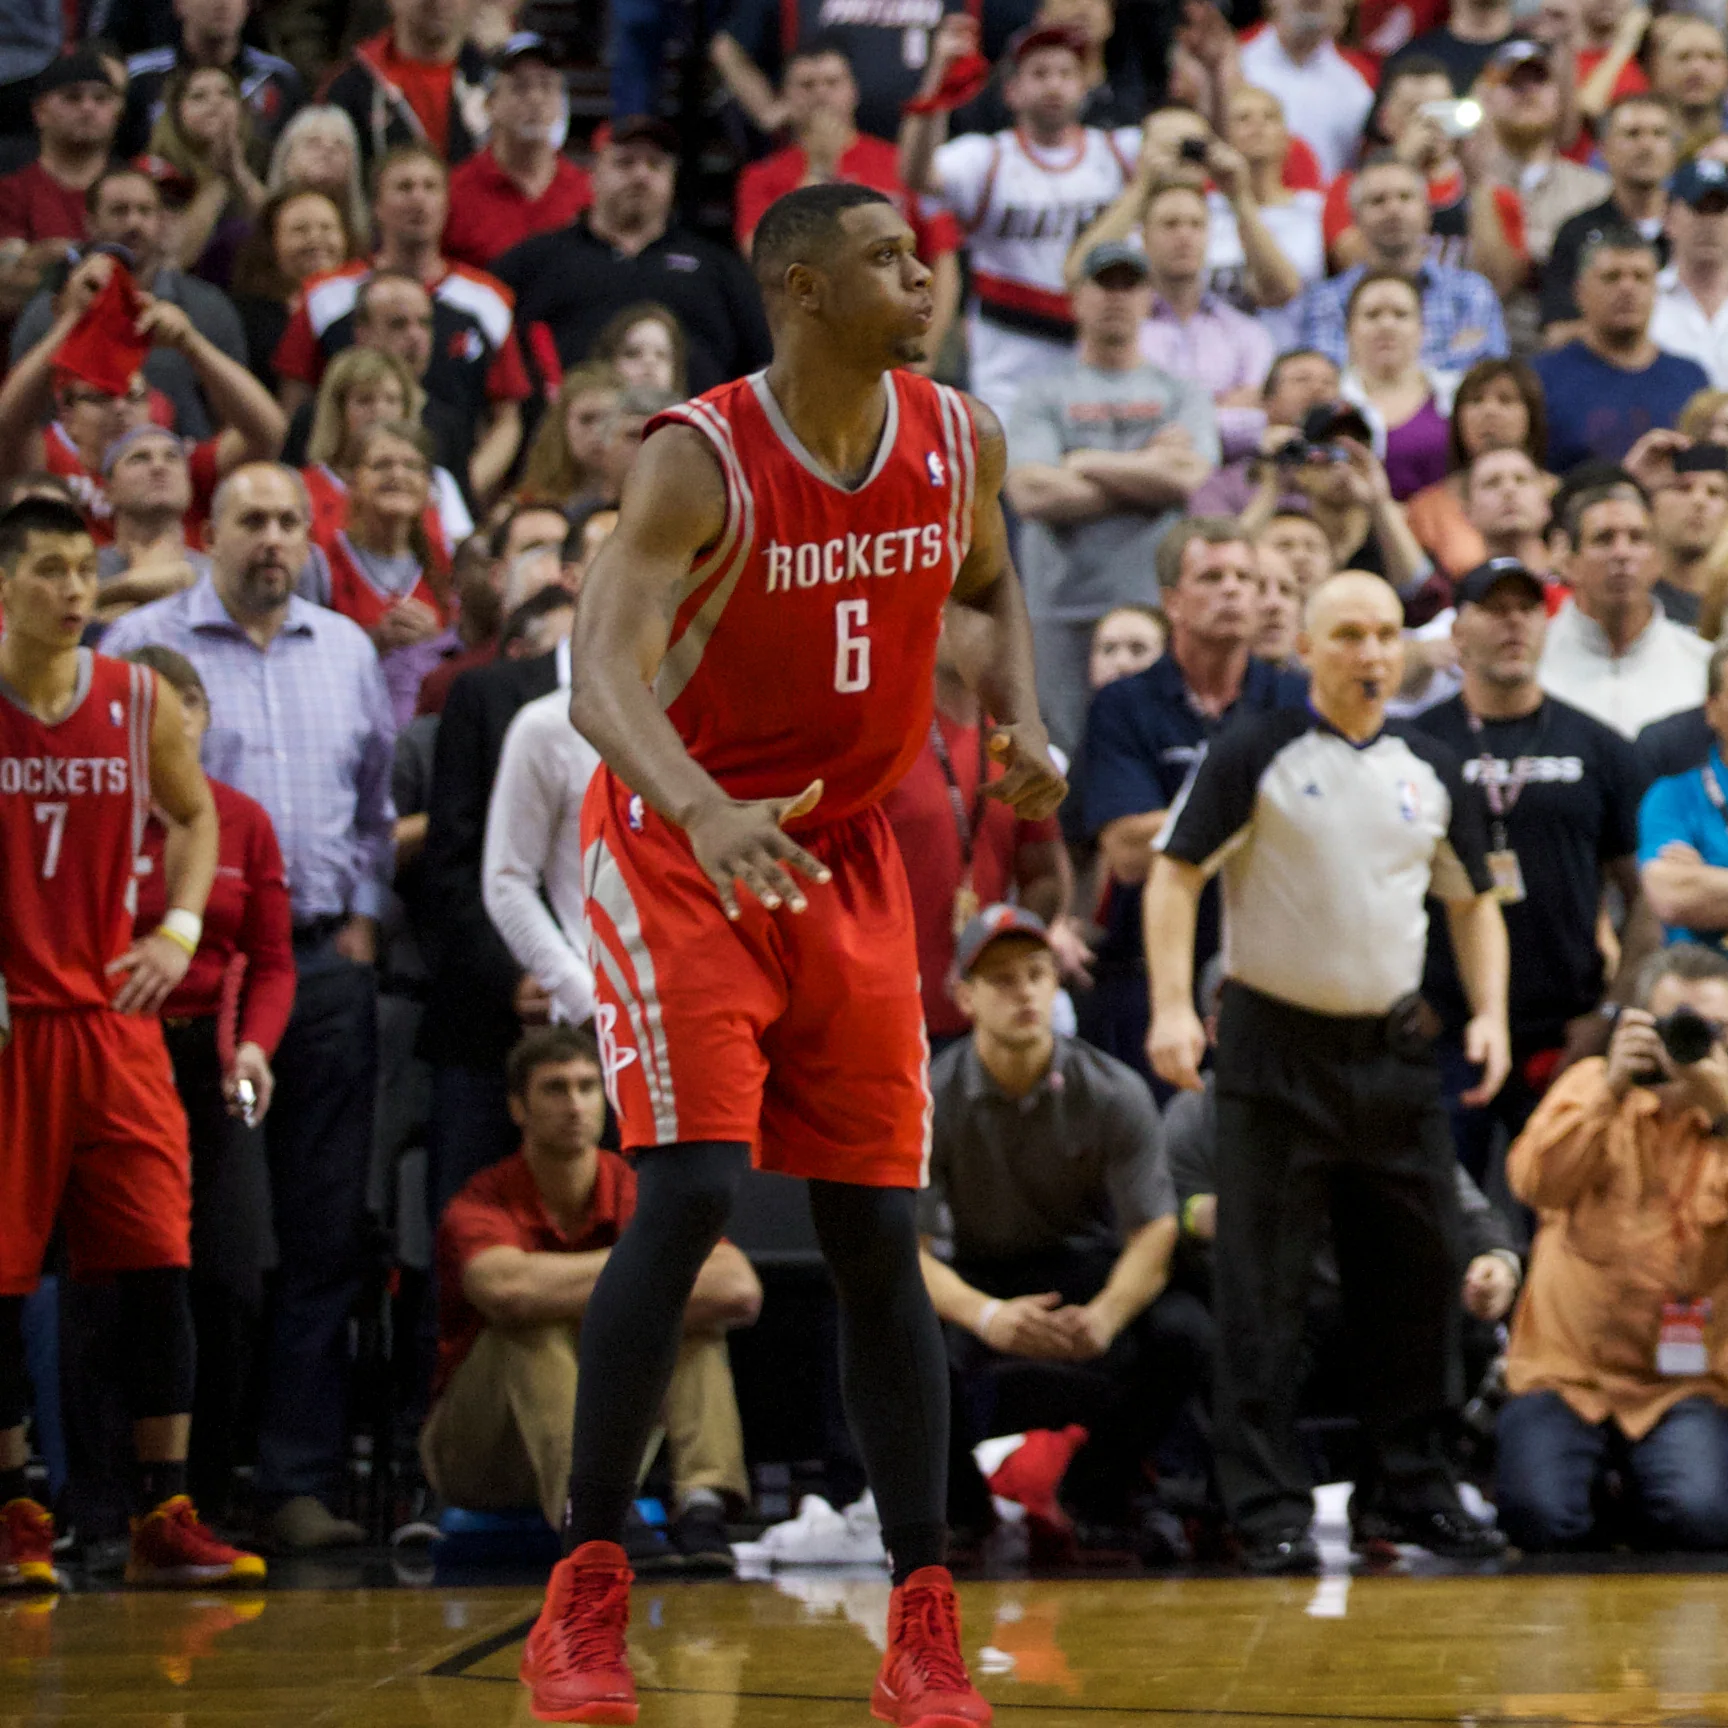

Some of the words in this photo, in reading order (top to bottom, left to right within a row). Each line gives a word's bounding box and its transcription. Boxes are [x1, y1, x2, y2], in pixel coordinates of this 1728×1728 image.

[760, 522, 943, 595] ROCKETS
[832, 597, 872, 695] 6
[0, 756, 128, 795] OCKETS
[33, 801, 69, 880] 7
